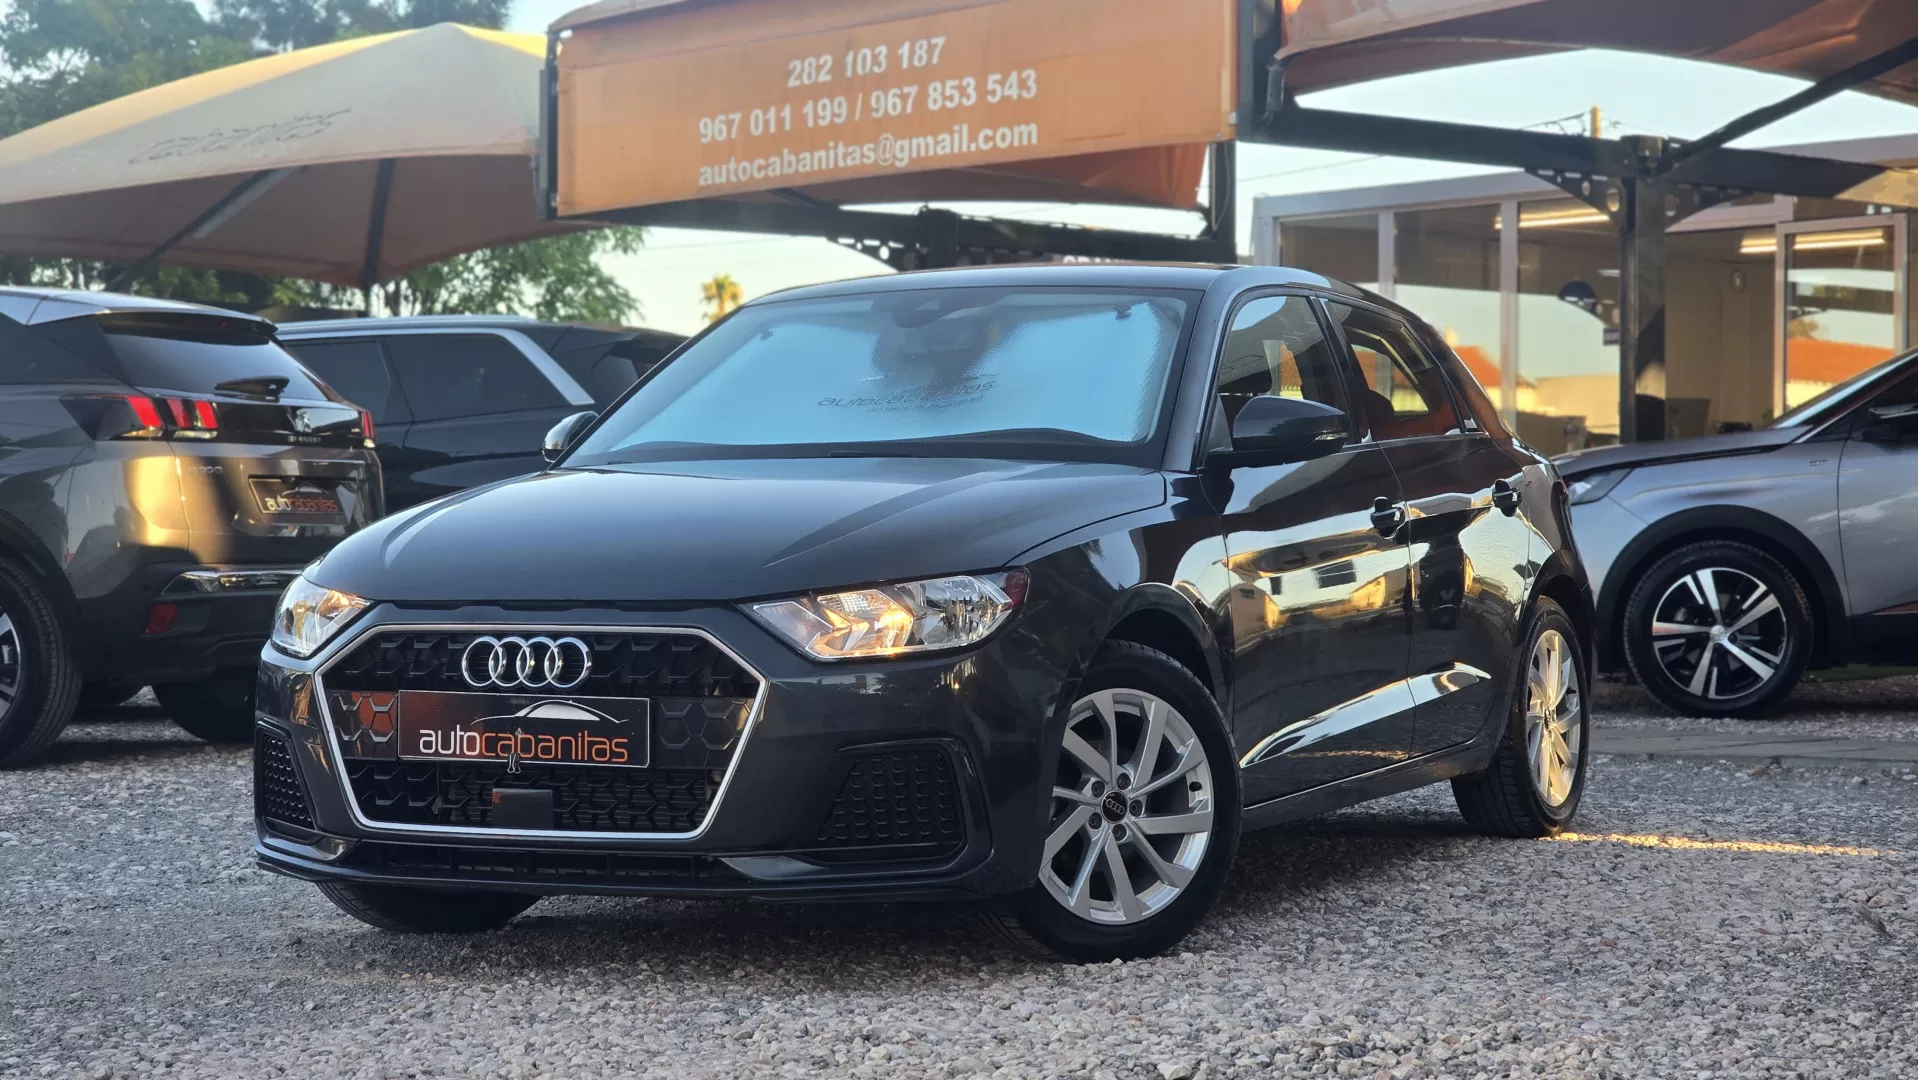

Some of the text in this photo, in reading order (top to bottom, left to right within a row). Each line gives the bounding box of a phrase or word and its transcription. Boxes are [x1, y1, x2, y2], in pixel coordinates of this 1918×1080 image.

[786, 35, 947, 88] 282 103 187
[698, 68, 1038, 144] 967 011 199 / 967 853 543
[698, 122, 1039, 186] autocabanitas@gmail.com
[418, 723, 629, 763] autocabanitas
